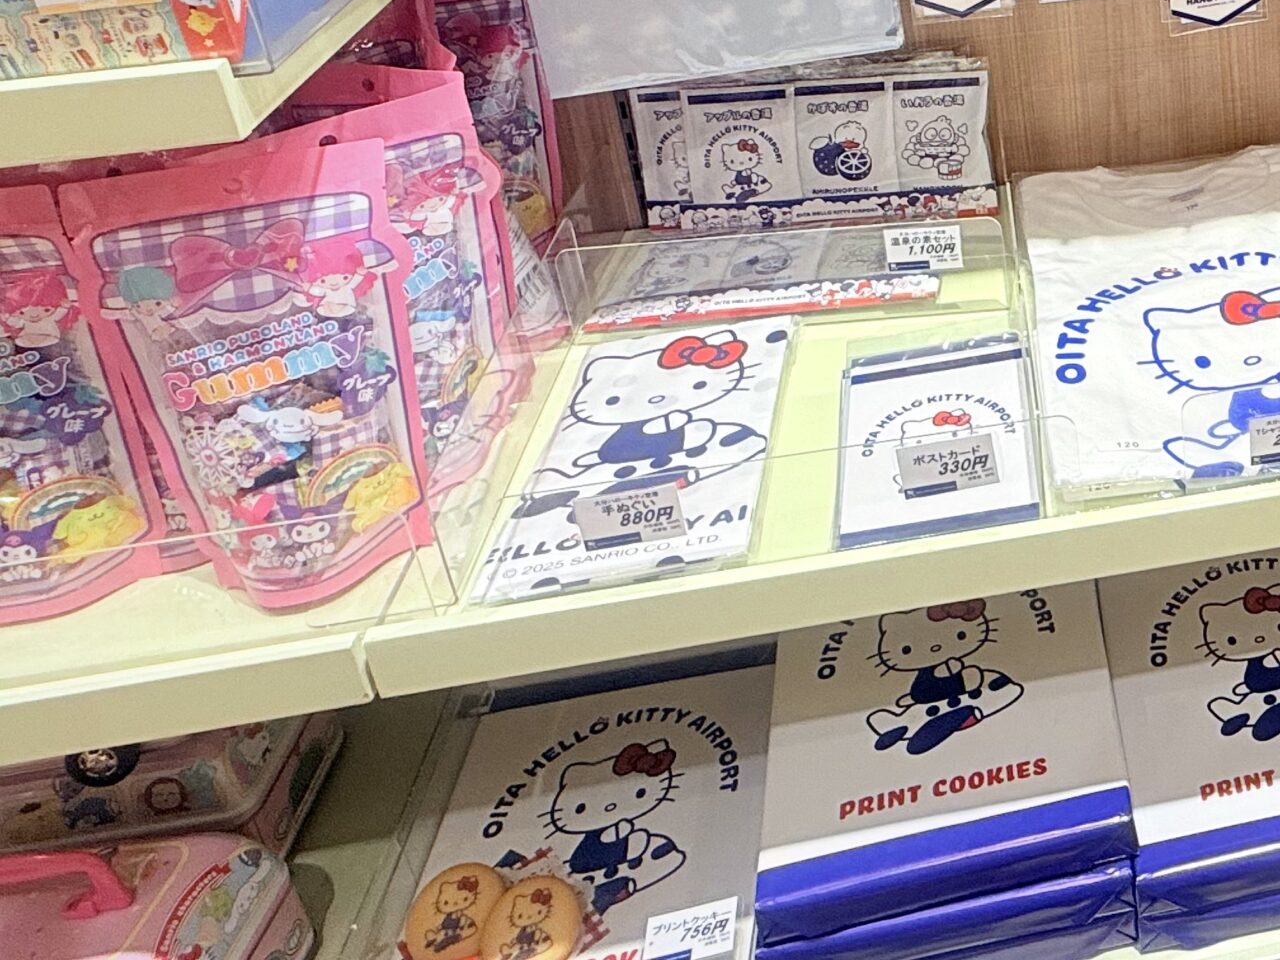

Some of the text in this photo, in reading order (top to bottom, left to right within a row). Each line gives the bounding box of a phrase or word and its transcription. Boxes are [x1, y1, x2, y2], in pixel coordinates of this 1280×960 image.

[704, 124, 783, 168] OITA HELLO KITTY AIRPORT
[909, 243, 956, 256] 1,100円
[166, 311, 314, 367] SANRIO PUROLAND
[1056, 317, 1093, 385] OITA
[1078, 267, 1182, 314] HELLO
[162, 324, 365, 412] Gummy
[192, 362, 206, 376] &
[342, 372, 392, 390] グレープ
[358, 388, 374, 402] 味
[46, 403, 107, 419] グレープ
[64, 419, 85, 433] 味
[861, 393, 1017, 457] OITA HELLO KITTY AIRPORT
[913, 444, 981, 466] ポストカード
[939, 454, 989, 476] 330円
[601, 499, 656, 516] 手ぬぐい
[620, 506, 674, 526] 880円
[521, 559, 565, 577] 2025
[569, 546, 640, 566] SANRIO
[686, 534, 722, 548] LTD.
[1150, 619, 1171, 667] OITA
[1164, 566, 1222, 617] HELLO
[817, 630, 849, 680] OITA
[484, 706, 740, 839] OITA HELLO KITTY AIRPORT
[1199, 768, 1276, 802] PRINT
[838, 756, 1048, 821] PRINT COOKIES
[653, 910, 732, 936] プリントクッキー
[680, 918, 730, 942] 756円
